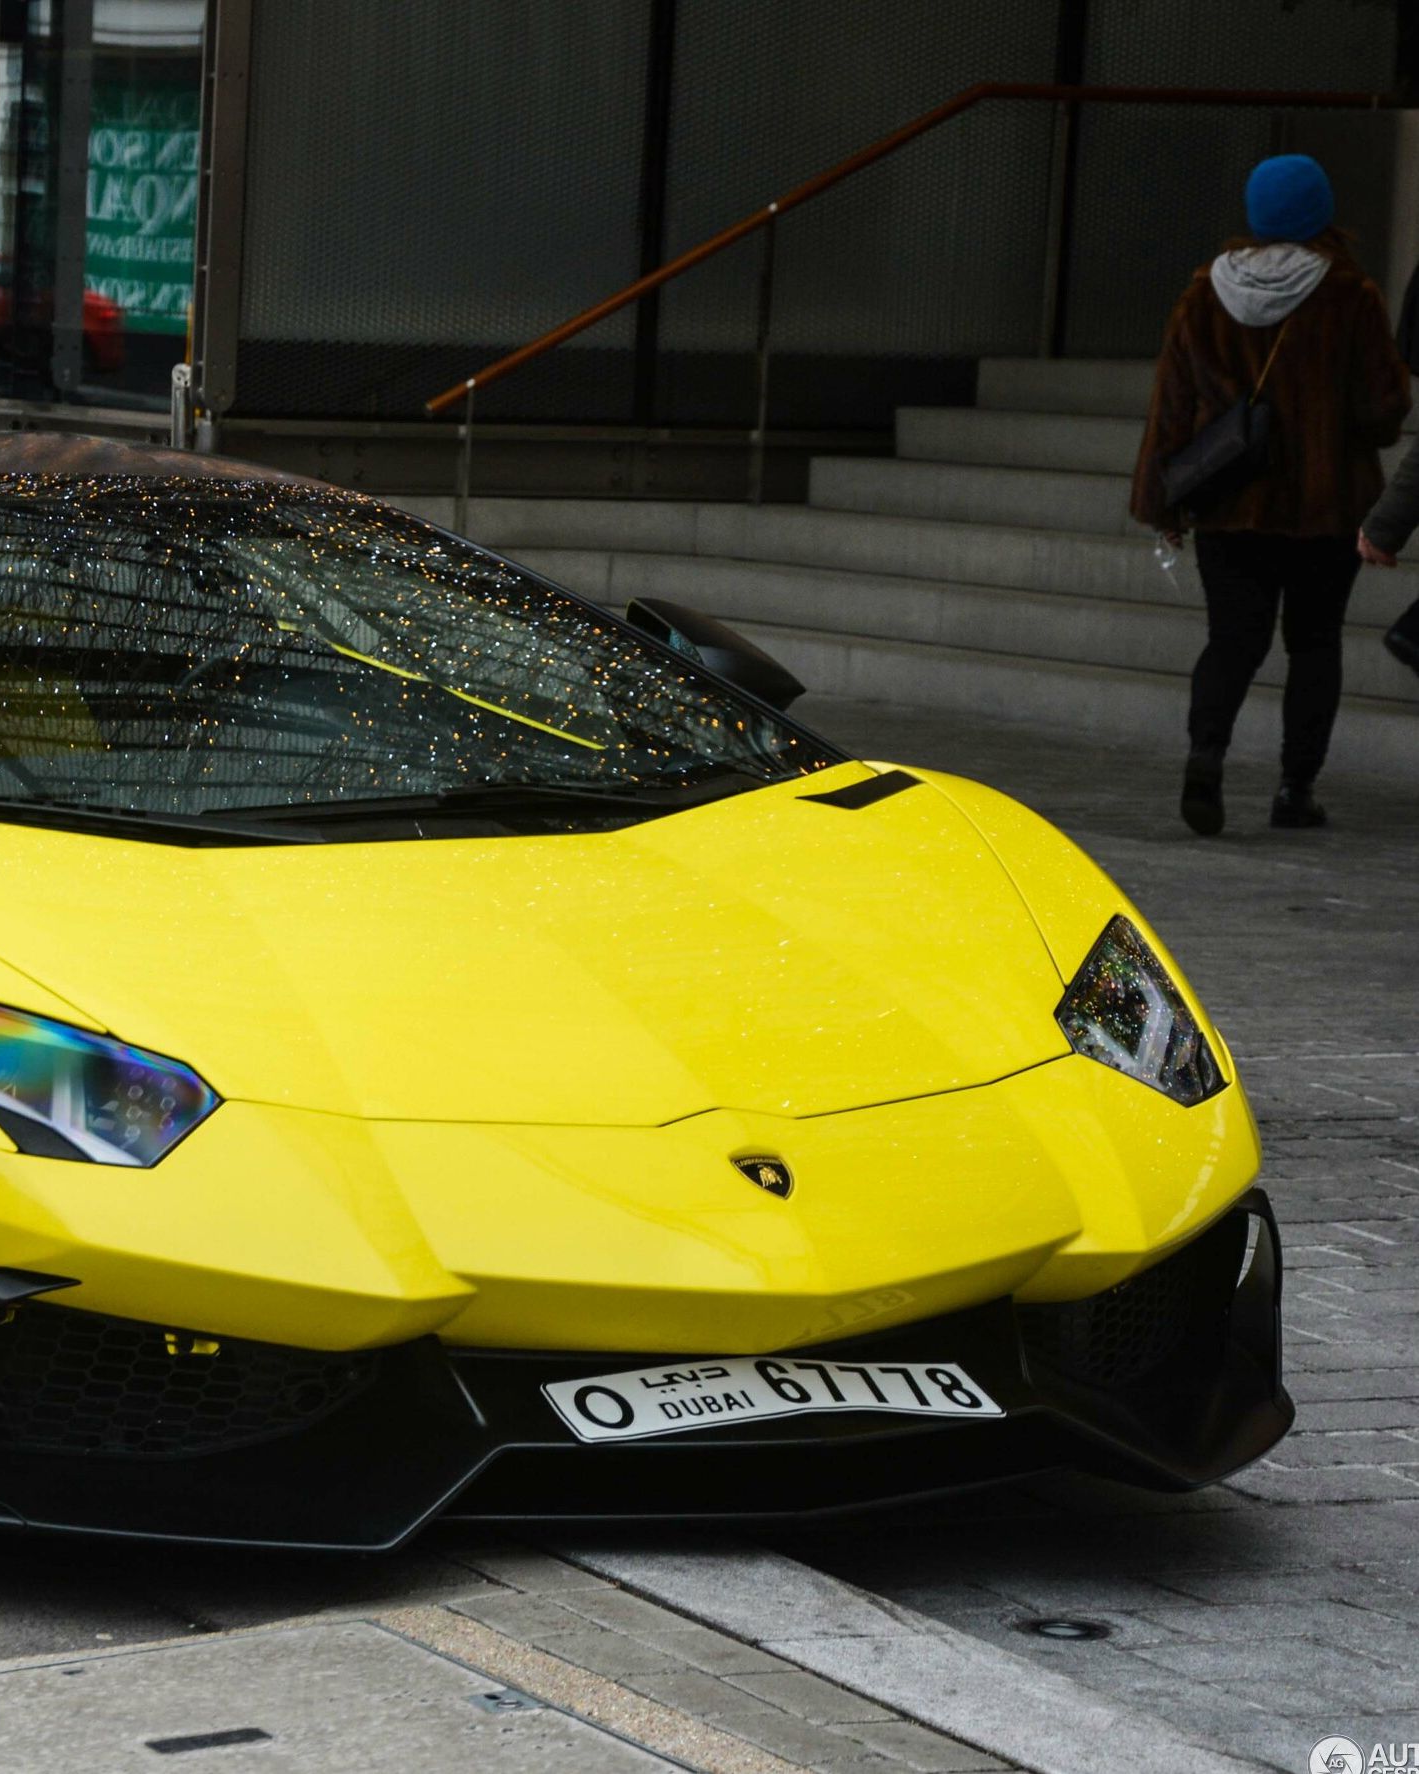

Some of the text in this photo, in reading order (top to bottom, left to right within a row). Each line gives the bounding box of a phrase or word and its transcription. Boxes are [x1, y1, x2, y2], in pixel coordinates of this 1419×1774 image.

[639, 1366, 731, 1394] دبي
[754, 1360, 983, 1409] 67778
[574, 1385, 635, 1430] O
[658, 1390, 755, 1420] DUBAI
